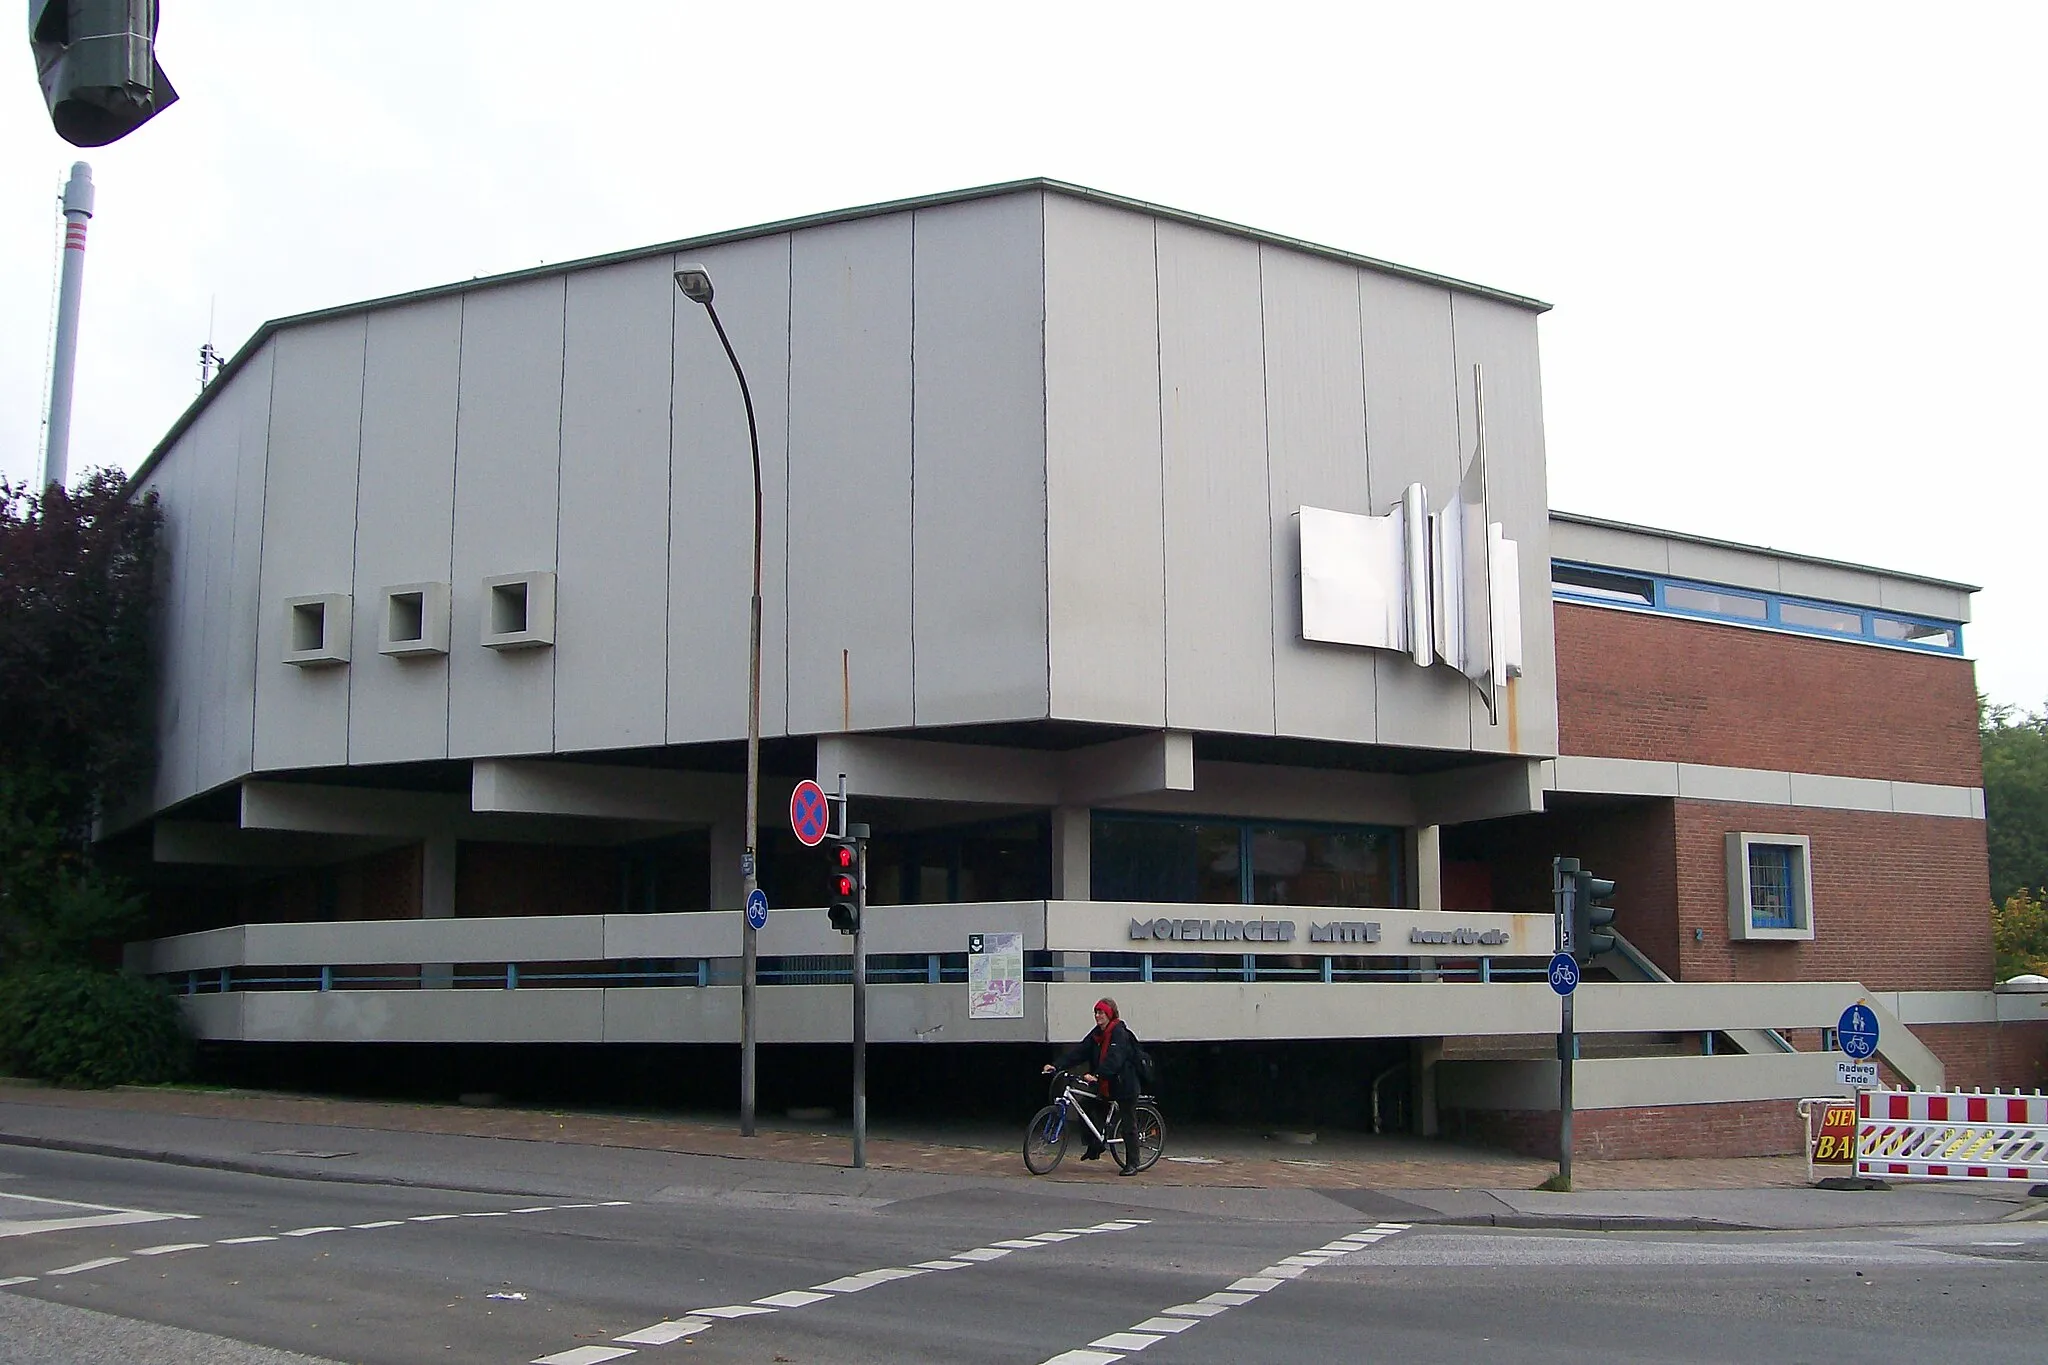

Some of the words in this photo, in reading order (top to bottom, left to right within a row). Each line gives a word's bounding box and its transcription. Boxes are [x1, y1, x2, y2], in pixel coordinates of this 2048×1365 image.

[1131, 917, 1296, 941] MOISLINGER
[1311, 921, 1382, 943] MITTE
[1838, 1063, 1875, 1076] Radweg
[1845, 1074, 1869, 1084] Ende
